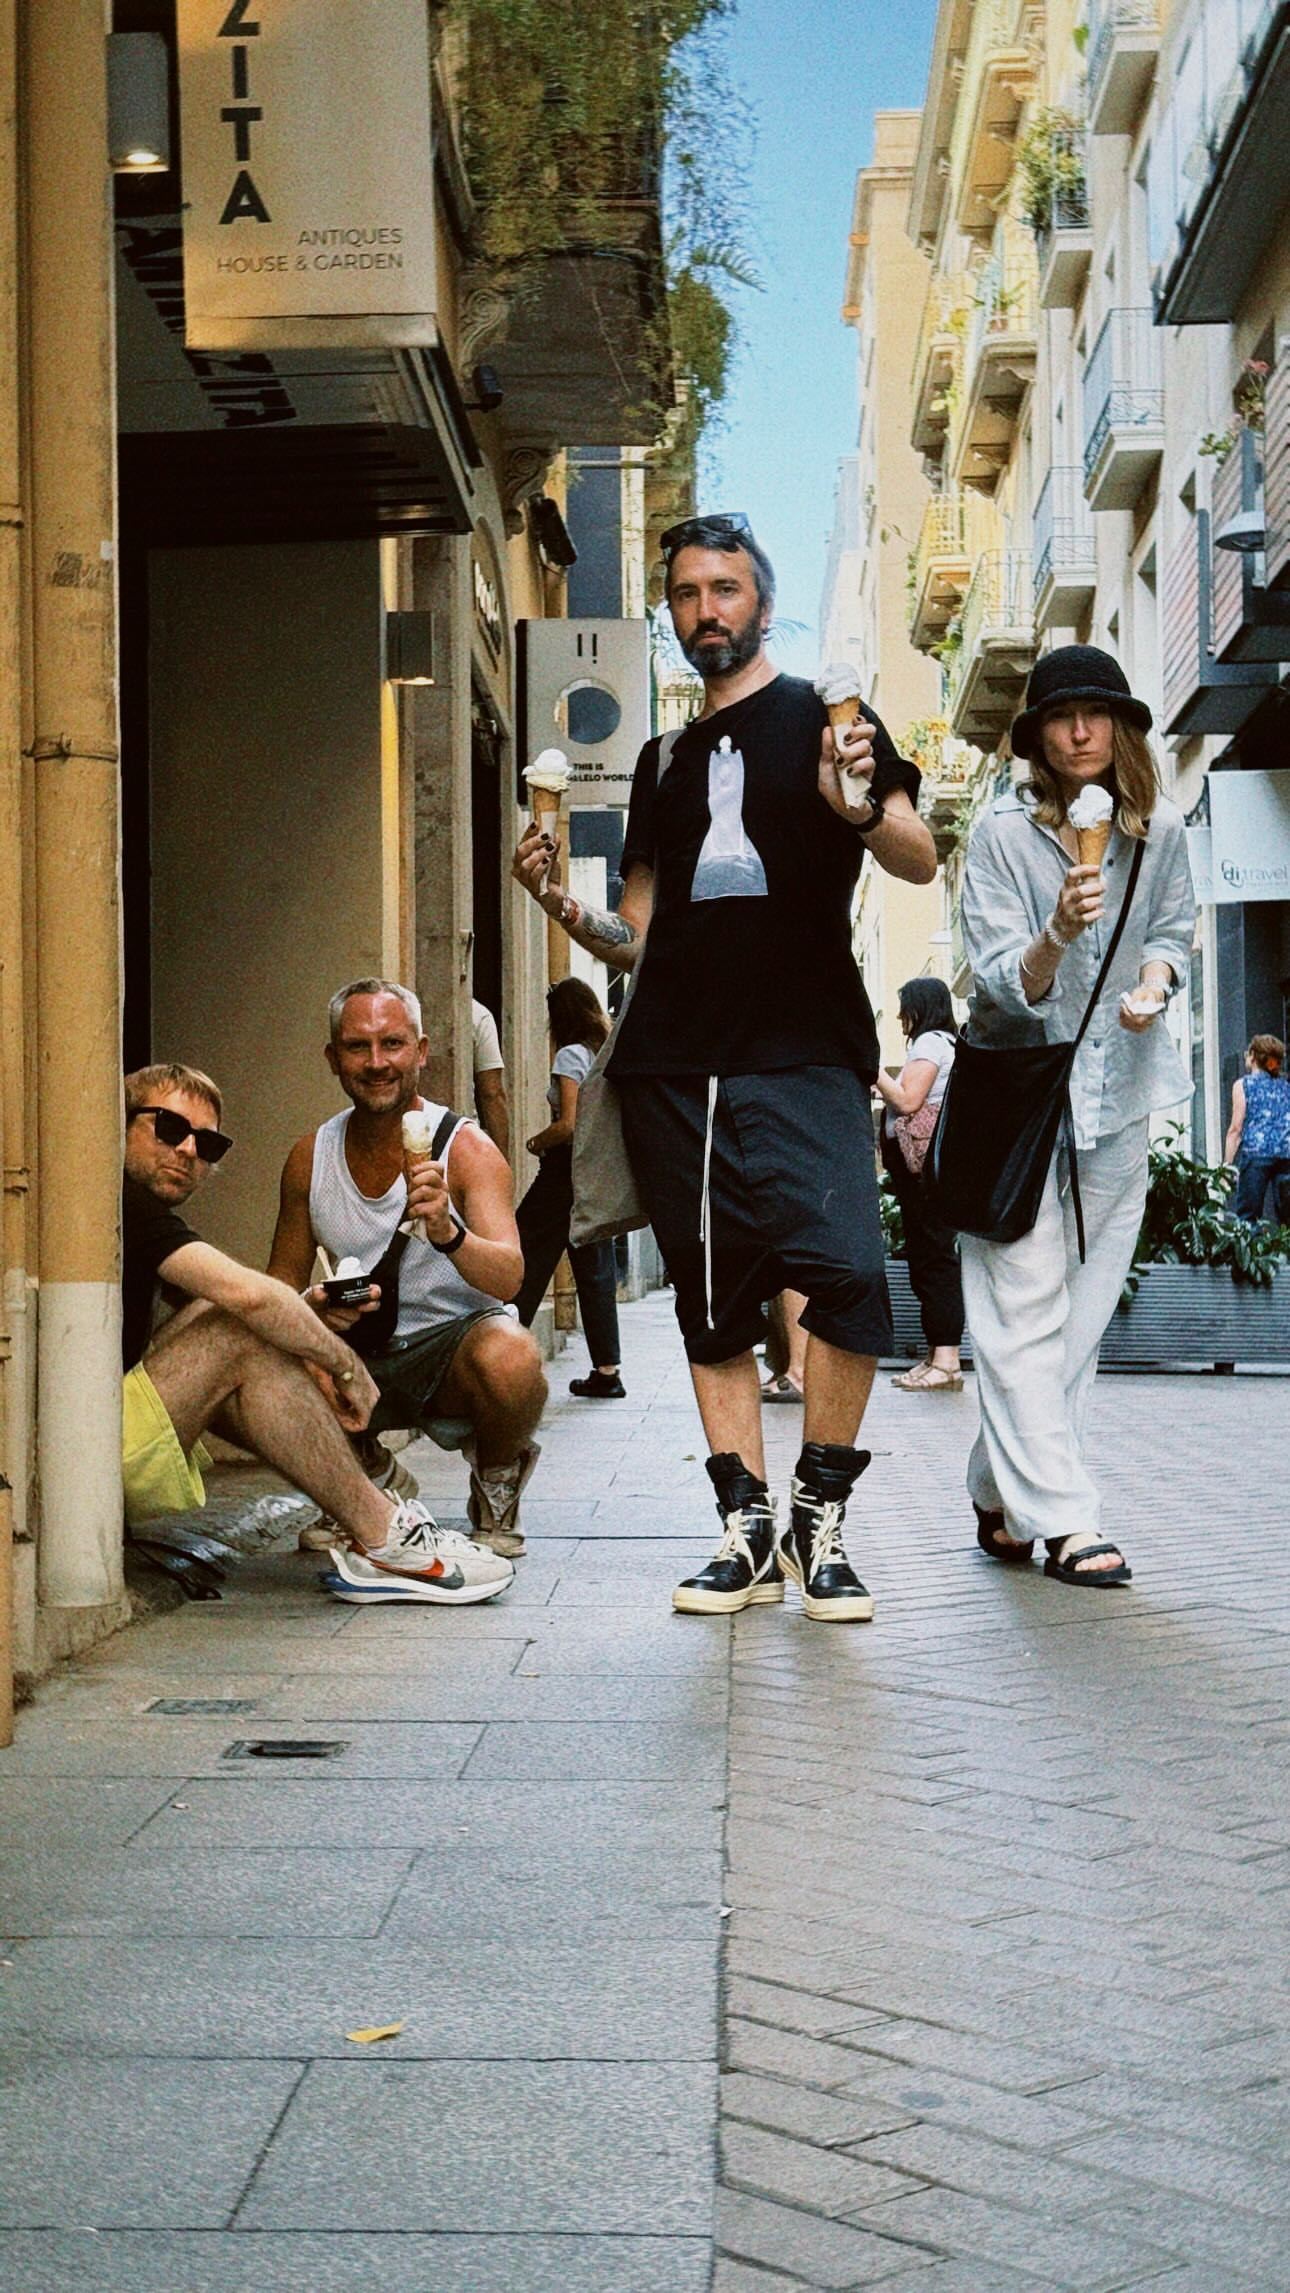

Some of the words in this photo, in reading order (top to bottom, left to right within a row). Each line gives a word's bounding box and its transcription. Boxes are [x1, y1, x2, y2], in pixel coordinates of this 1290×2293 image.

[217, 0, 272, 225] ZITA
[298, 228, 402, 247] ANTIQUES
[217, 256, 288, 273] HOUSE
[296, 254, 307, 271] &
[313, 253, 403, 271] GARDEN
